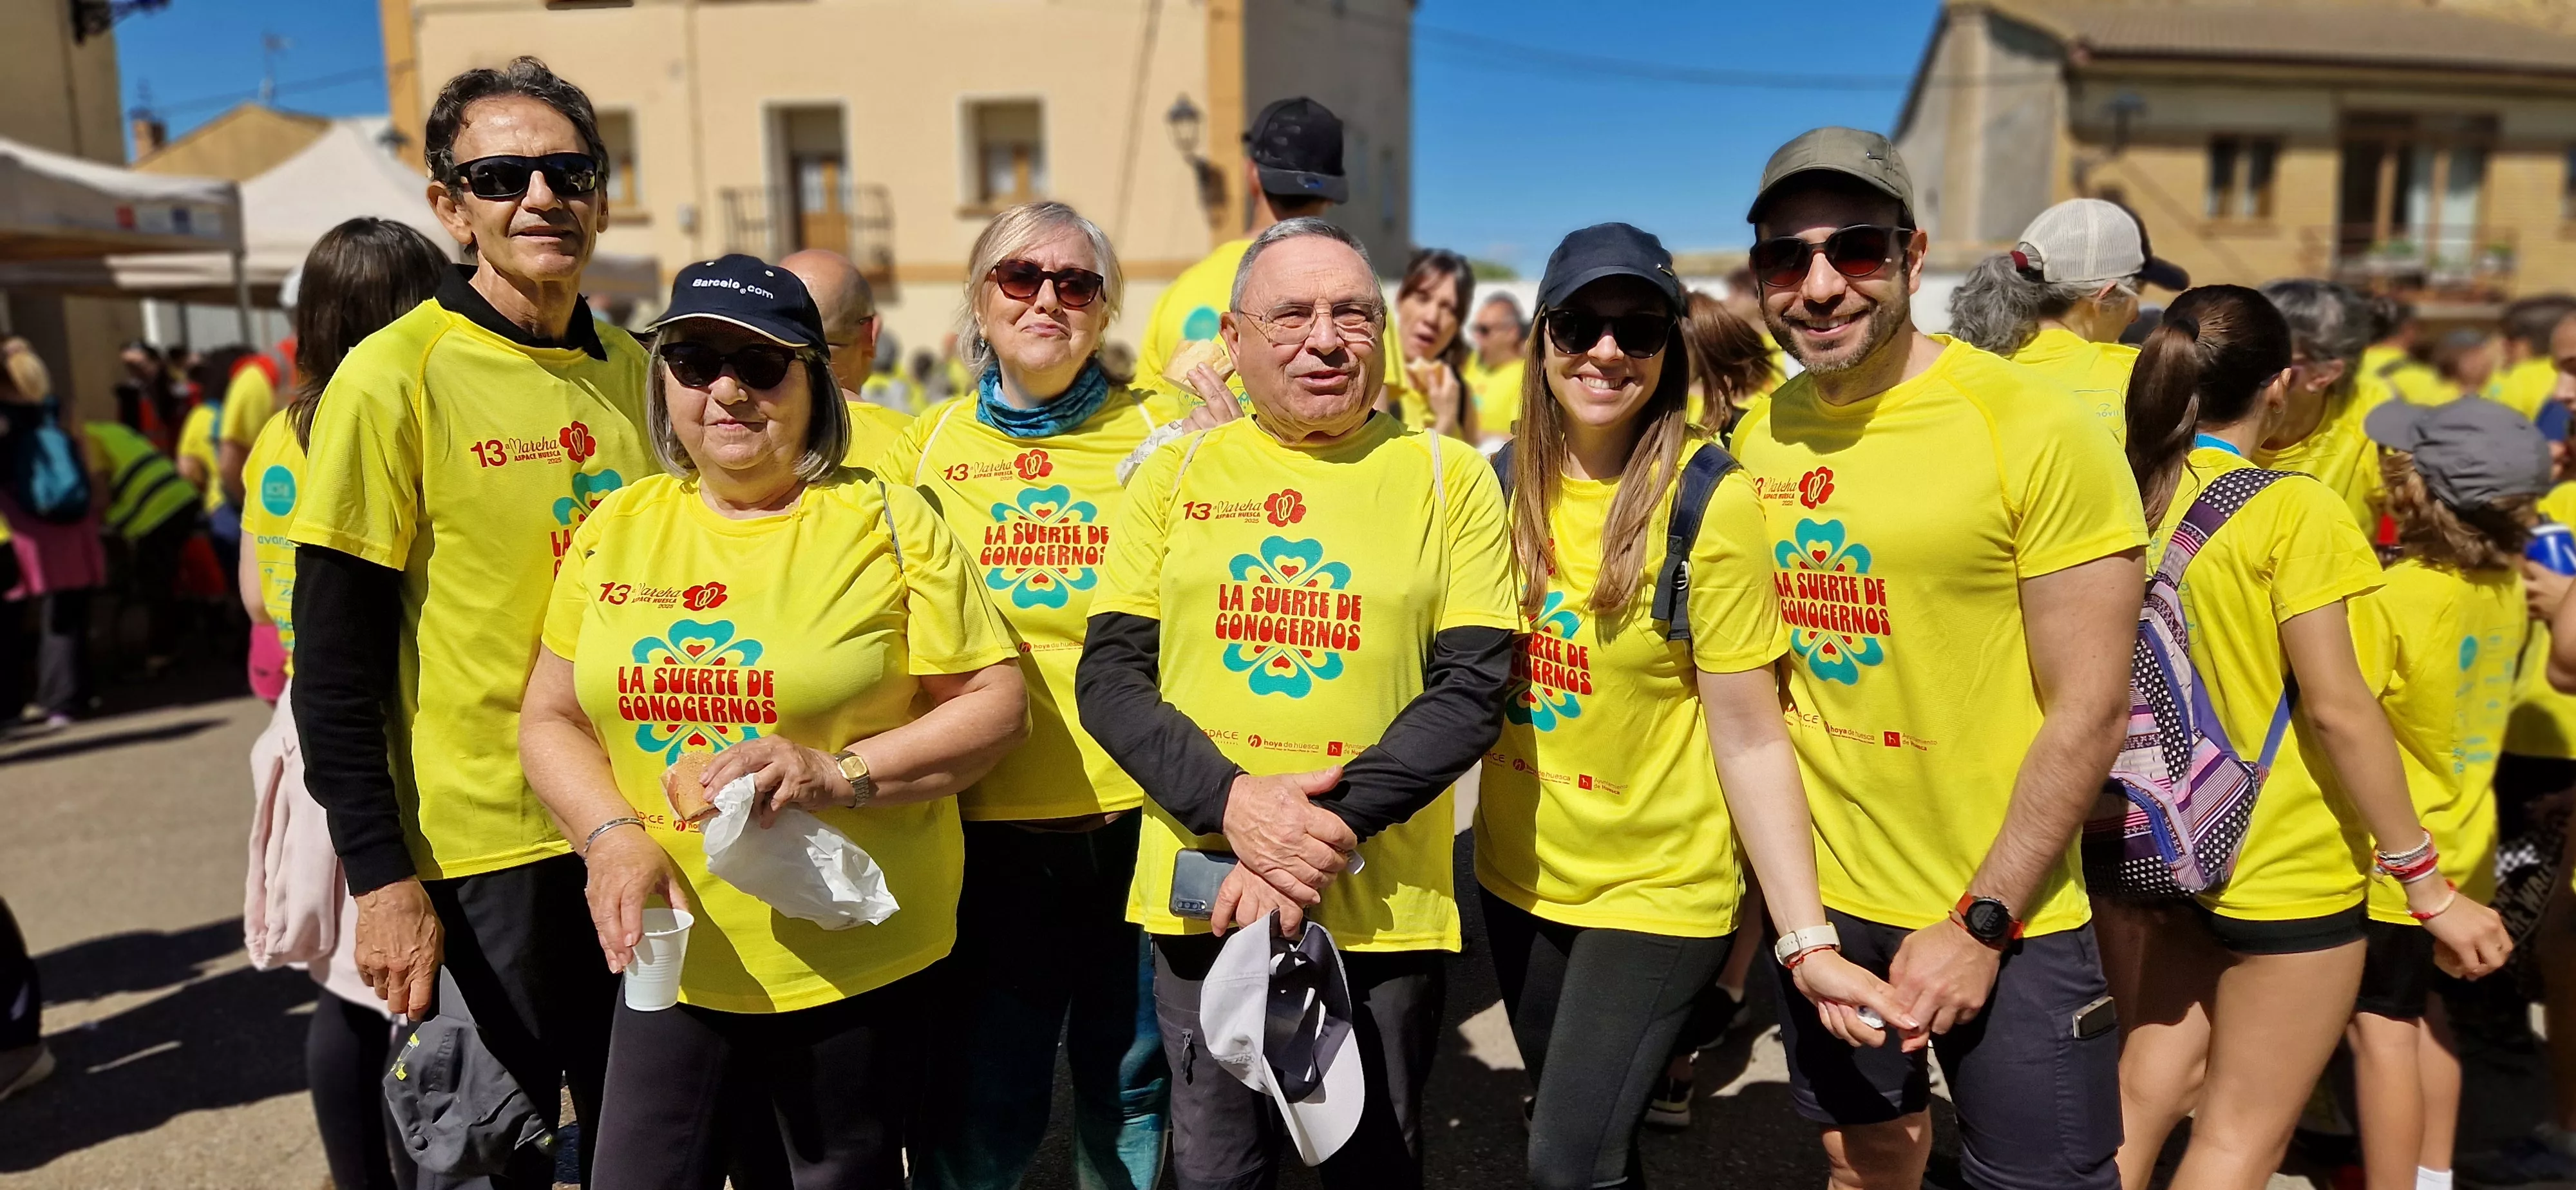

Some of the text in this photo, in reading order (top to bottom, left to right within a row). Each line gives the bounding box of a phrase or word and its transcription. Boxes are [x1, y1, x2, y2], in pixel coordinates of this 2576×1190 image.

[509, 436, 559, 455] Marcha
[514, 453, 536, 462] ASPACE
[974, 459, 1012, 473] Marcha
[1217, 499, 1262, 513] Marcha
[985, 522, 1109, 545] LA SUERTE DE
[1774, 571, 1887, 607] LA SUERTE DE
[1220, 583, 1362, 622] LA SUERTE DE
[1215, 613, 1361, 651] CONOCERNOS
[1567, 643, 1589, 671] DE
[618, 666, 774, 699] LA SUERTE DE
[618, 695, 777, 724] CONOCERNOS
[1264, 739, 1283, 747] hoya
